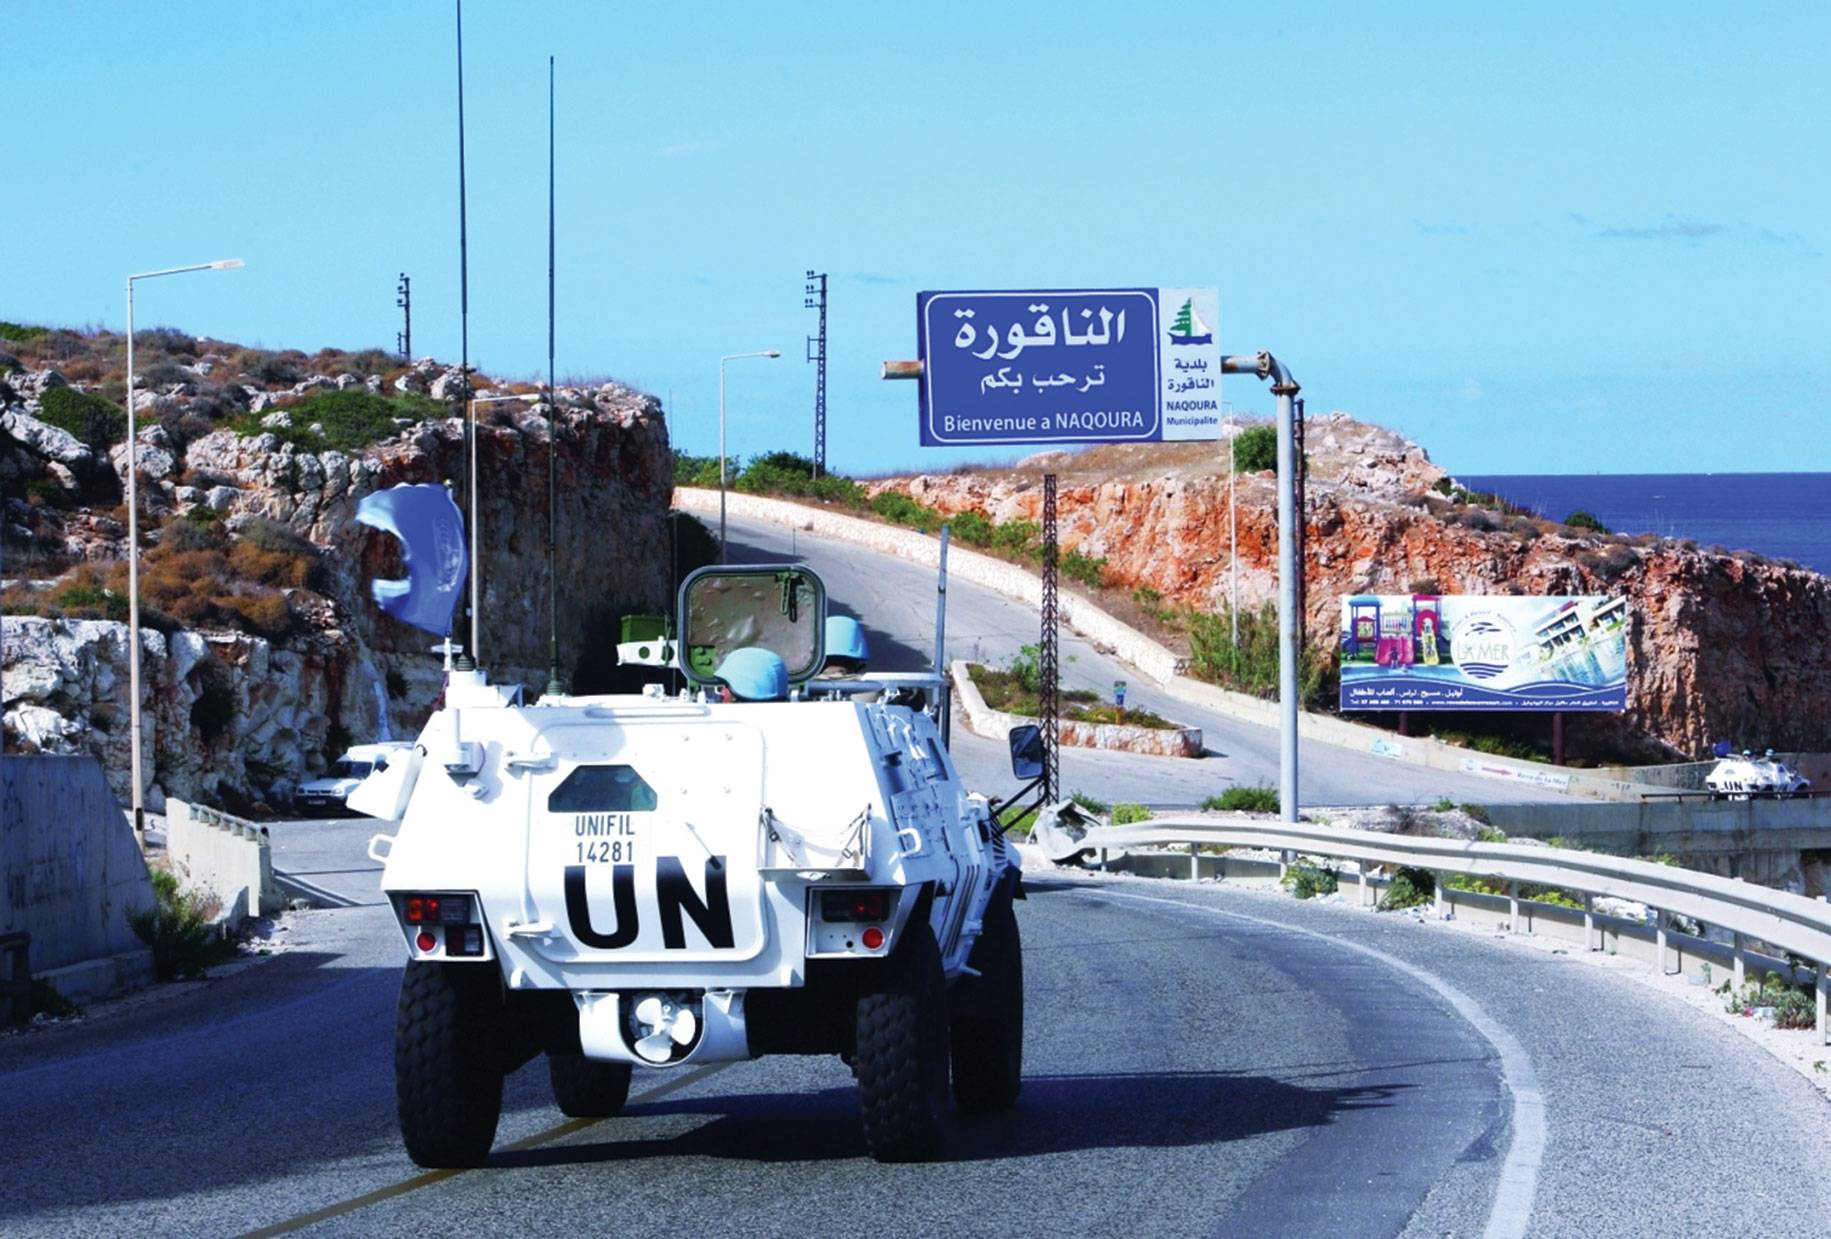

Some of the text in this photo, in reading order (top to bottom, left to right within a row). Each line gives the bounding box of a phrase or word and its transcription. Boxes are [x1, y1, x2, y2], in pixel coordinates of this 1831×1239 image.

[953, 303, 1125, 359] الناقورة
[1174, 358, 1208, 373] بلدية
[980, 364, 1105, 395] ترحب بكم
[1167, 377, 1214, 393] الناقورة
[1166, 400, 1218, 411] NAQOURA
[944, 411, 1144, 432] Bienvenue a NAQOURA
[1166, 415, 1218, 426] Municipalite
[1724, 781, 1744, 791] UN
[575, 814, 636, 837] UNIFIL
[576, 841, 634, 863] 14281
[564, 855, 736, 950] UN
